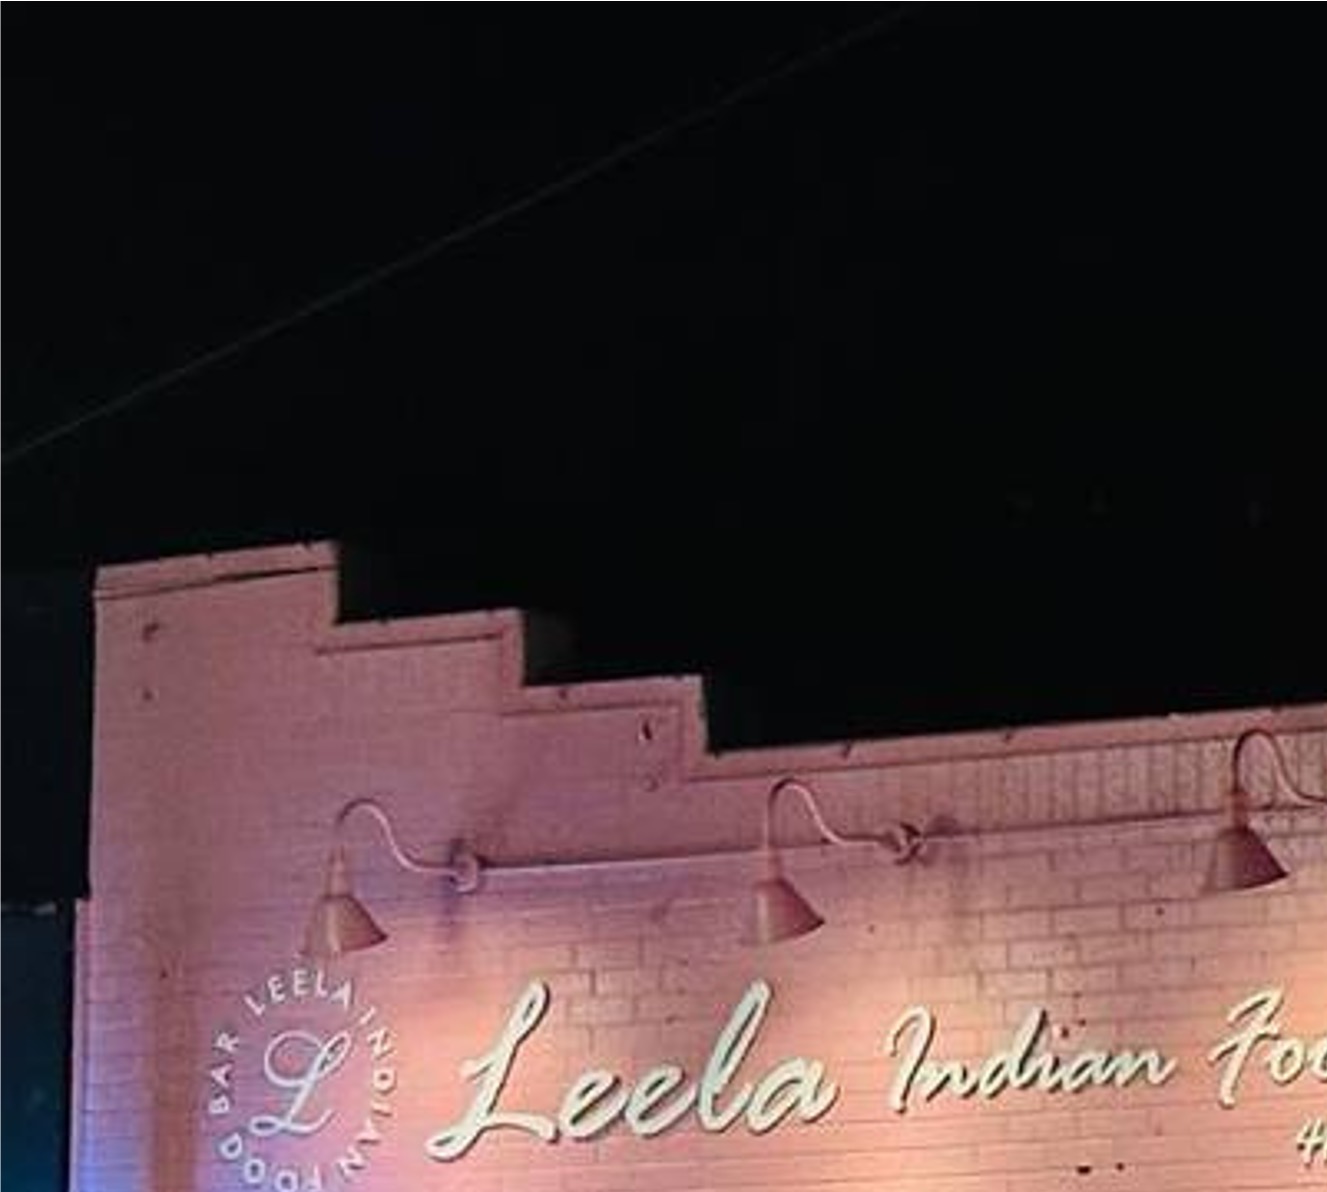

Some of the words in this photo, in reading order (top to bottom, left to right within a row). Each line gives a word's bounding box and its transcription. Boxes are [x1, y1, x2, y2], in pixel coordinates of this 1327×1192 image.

[243, 968, 356, 1017] LEELA
[207, 1031, 241, 1117] BAR
[328, 1004, 398, 1181] INDIAN
[425, 979, 841, 1163] Leela
[888, 1004, 1178, 1114] Indian
